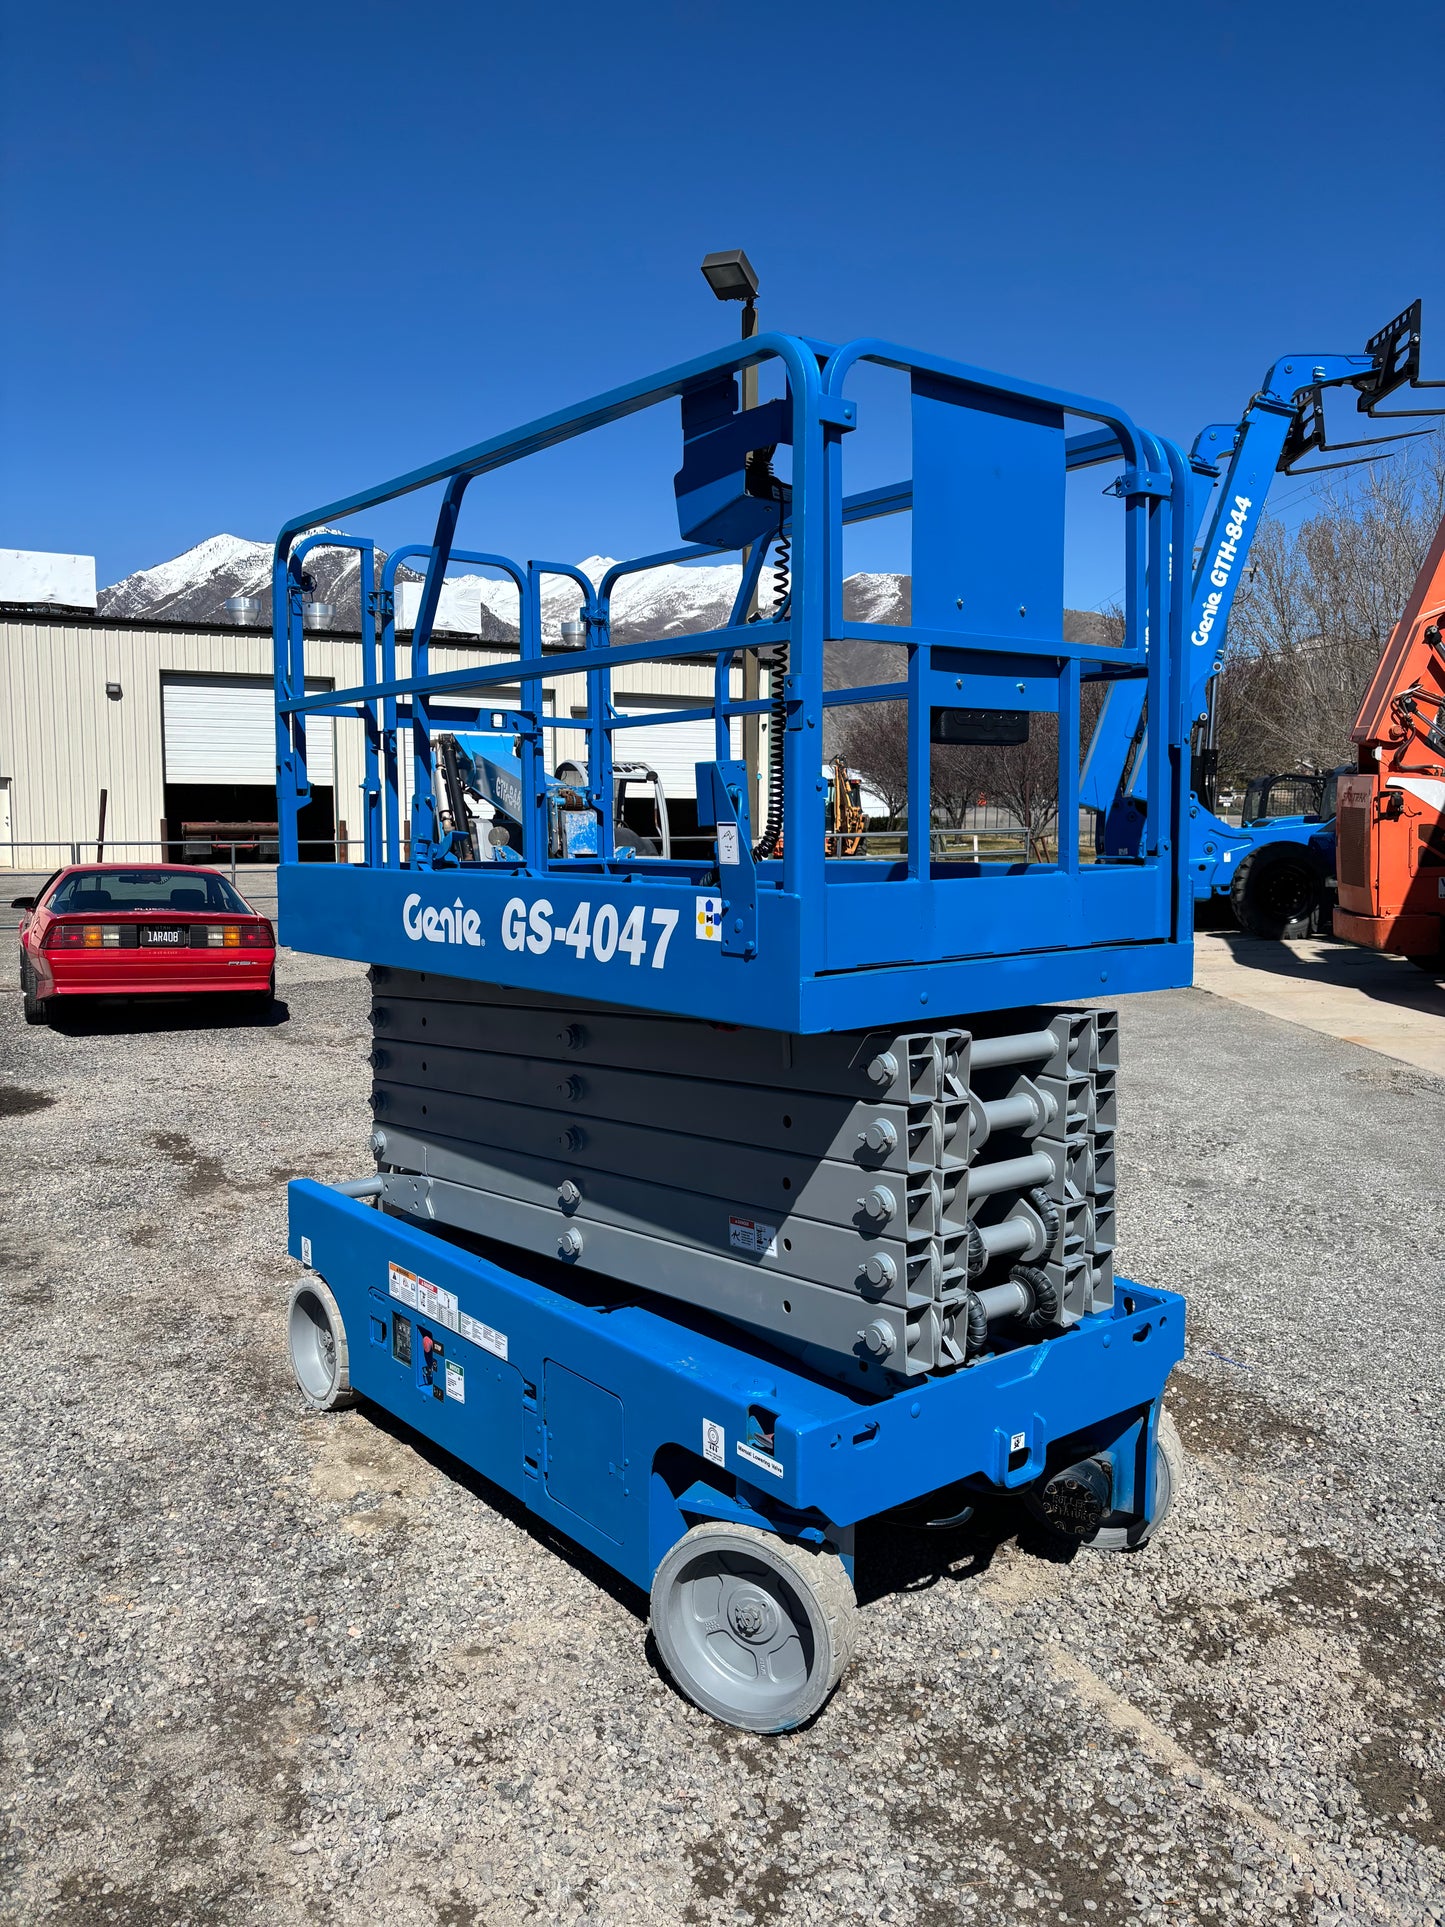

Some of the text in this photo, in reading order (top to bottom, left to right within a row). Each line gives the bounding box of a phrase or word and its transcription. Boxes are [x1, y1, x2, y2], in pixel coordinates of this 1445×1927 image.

[1191, 495, 1252, 647] Genie GTH-844
[403, 893, 680, 969] Genie GS-4047
[752, 1452, 771, 1468] Lowering
